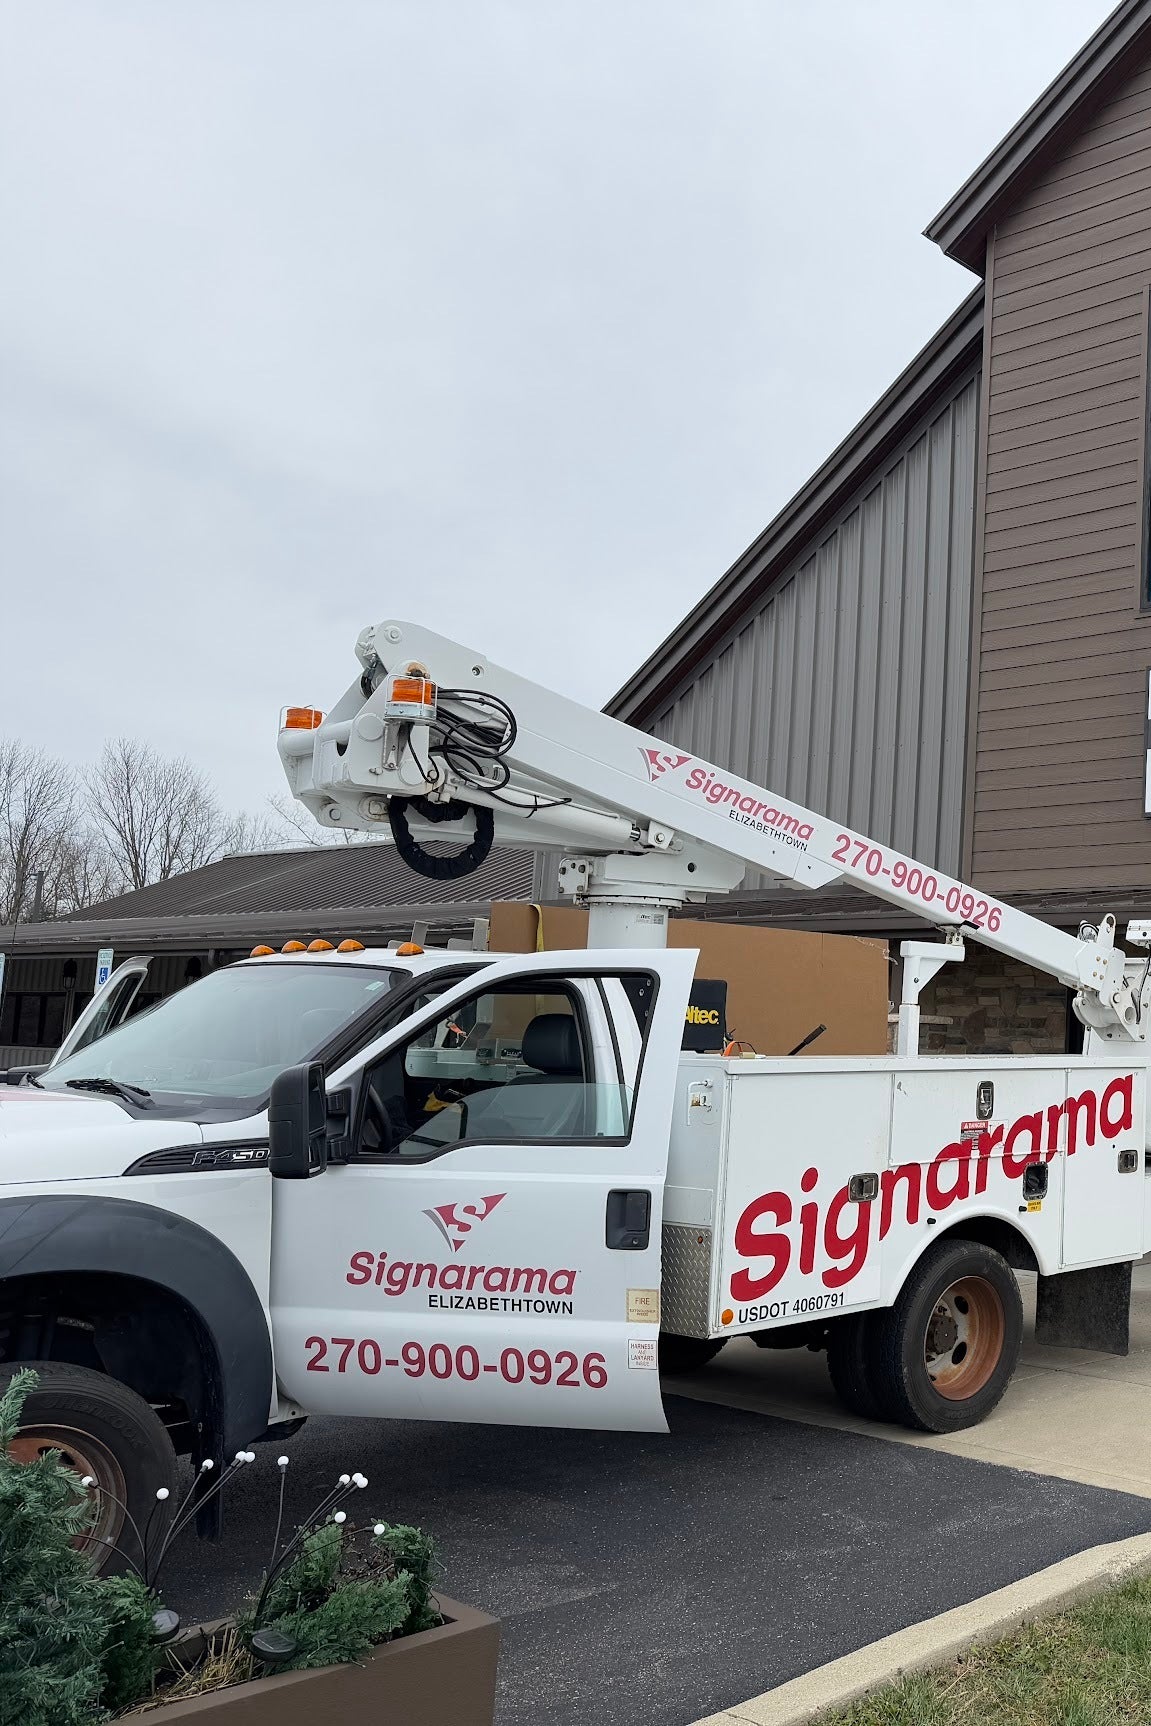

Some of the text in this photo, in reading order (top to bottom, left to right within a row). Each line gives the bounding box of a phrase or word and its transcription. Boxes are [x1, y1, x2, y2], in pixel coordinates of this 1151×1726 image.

[685, 767, 815, 842] Signarama
[728, 809, 808, 852] ELIZABETHTOWN
[831, 833, 1003, 933] 270-900-0926
[729, 1072, 1134, 1304] Signarama
[346, 1250, 578, 1297] Signarama
[428, 1294, 574, 1315] ELIZABETHTOWN
[635, 1297, 650, 1305] FIRE
[737, 1291, 846, 1324] USDOT 4060791
[304, 1335, 608, 1389] 270-900-0926
